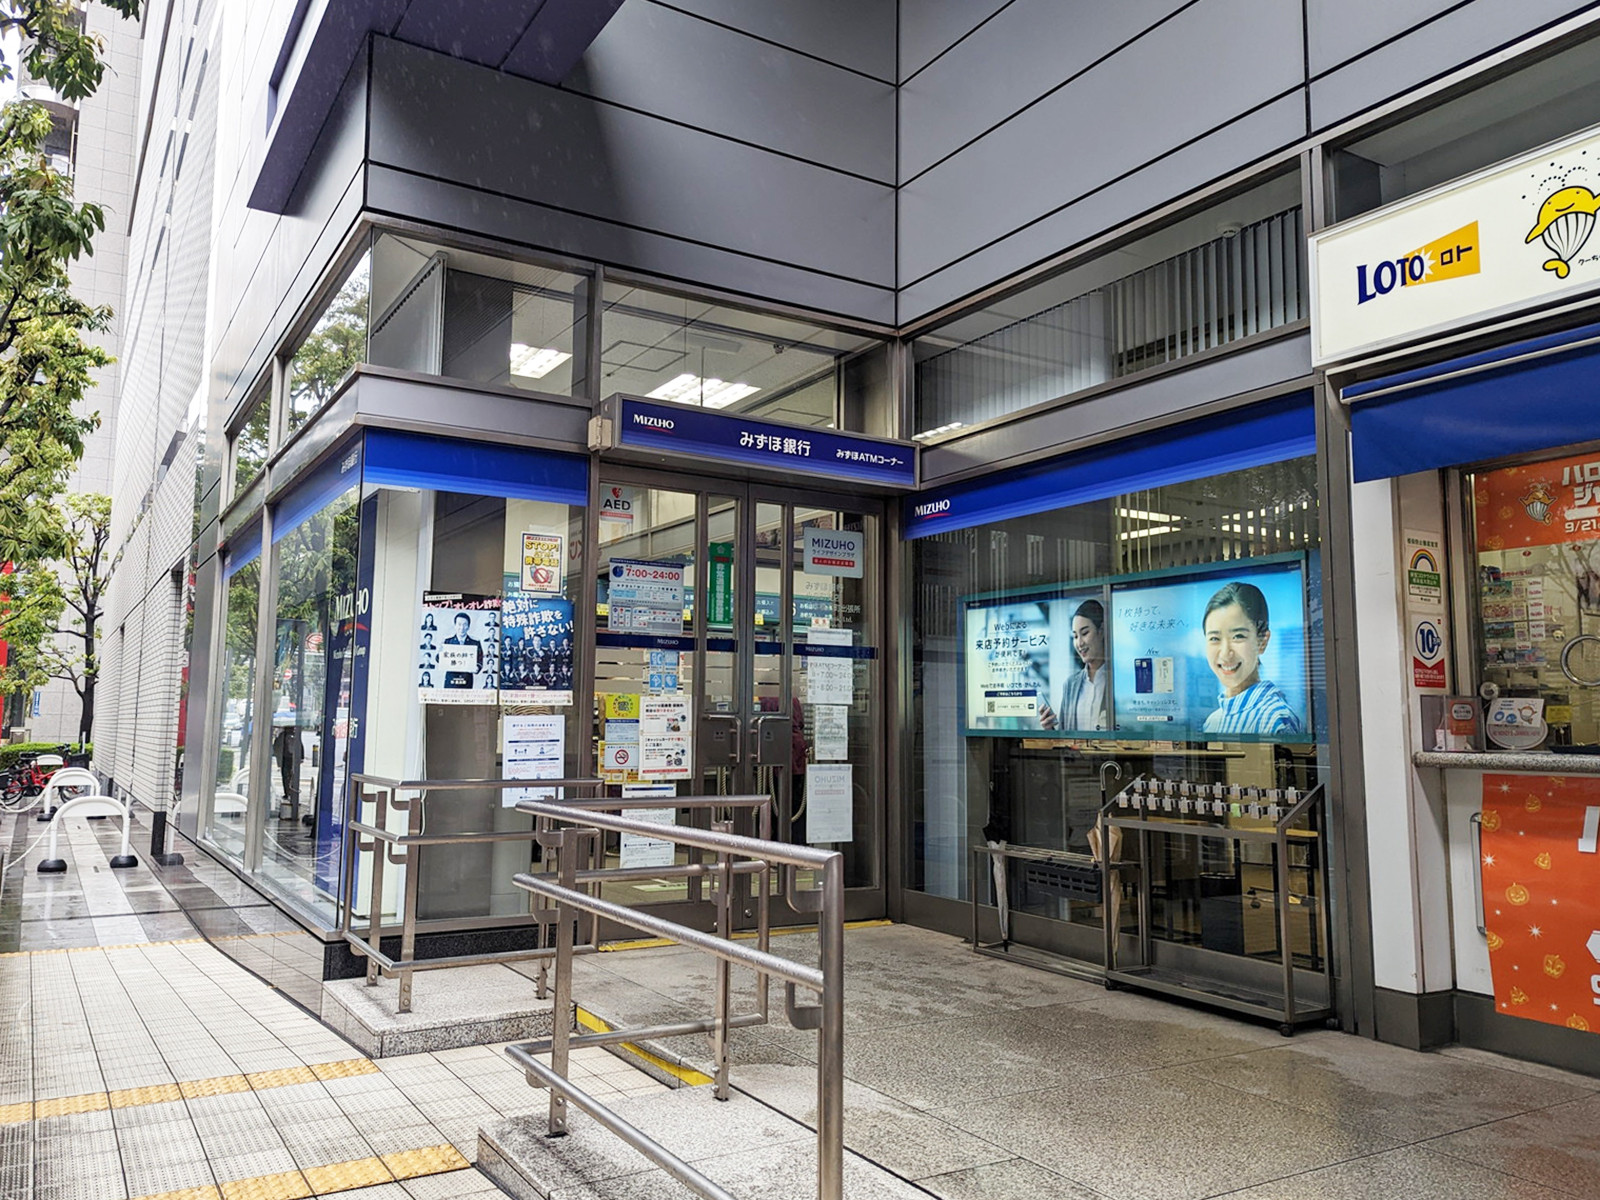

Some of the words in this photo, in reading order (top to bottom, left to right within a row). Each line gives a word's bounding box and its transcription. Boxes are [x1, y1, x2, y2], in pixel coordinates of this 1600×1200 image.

[1440, 245, 1473, 266] ロト
[1356, 254, 1425, 305] LOTO
[633, 414, 675, 430] MIZUHO
[740, 431, 811, 457] みずほ銀行
[836, 448, 904, 466] みずほATMコーナー
[603, 498, 631, 511] AED
[914, 499, 950, 517] MIZUHO
[1565, 519, 1600, 533] 9/21
[525, 541, 559, 552] STOP!
[812, 538, 855, 551] MIZUHO
[502, 598, 539, 614] 絶対に
[502, 610, 563, 629] 特殊詐欺を
[994, 621, 1028, 631] Webによる
[524, 620, 574, 640] 許さない!
[975, 634, 1048, 650] 来店予約サービス
